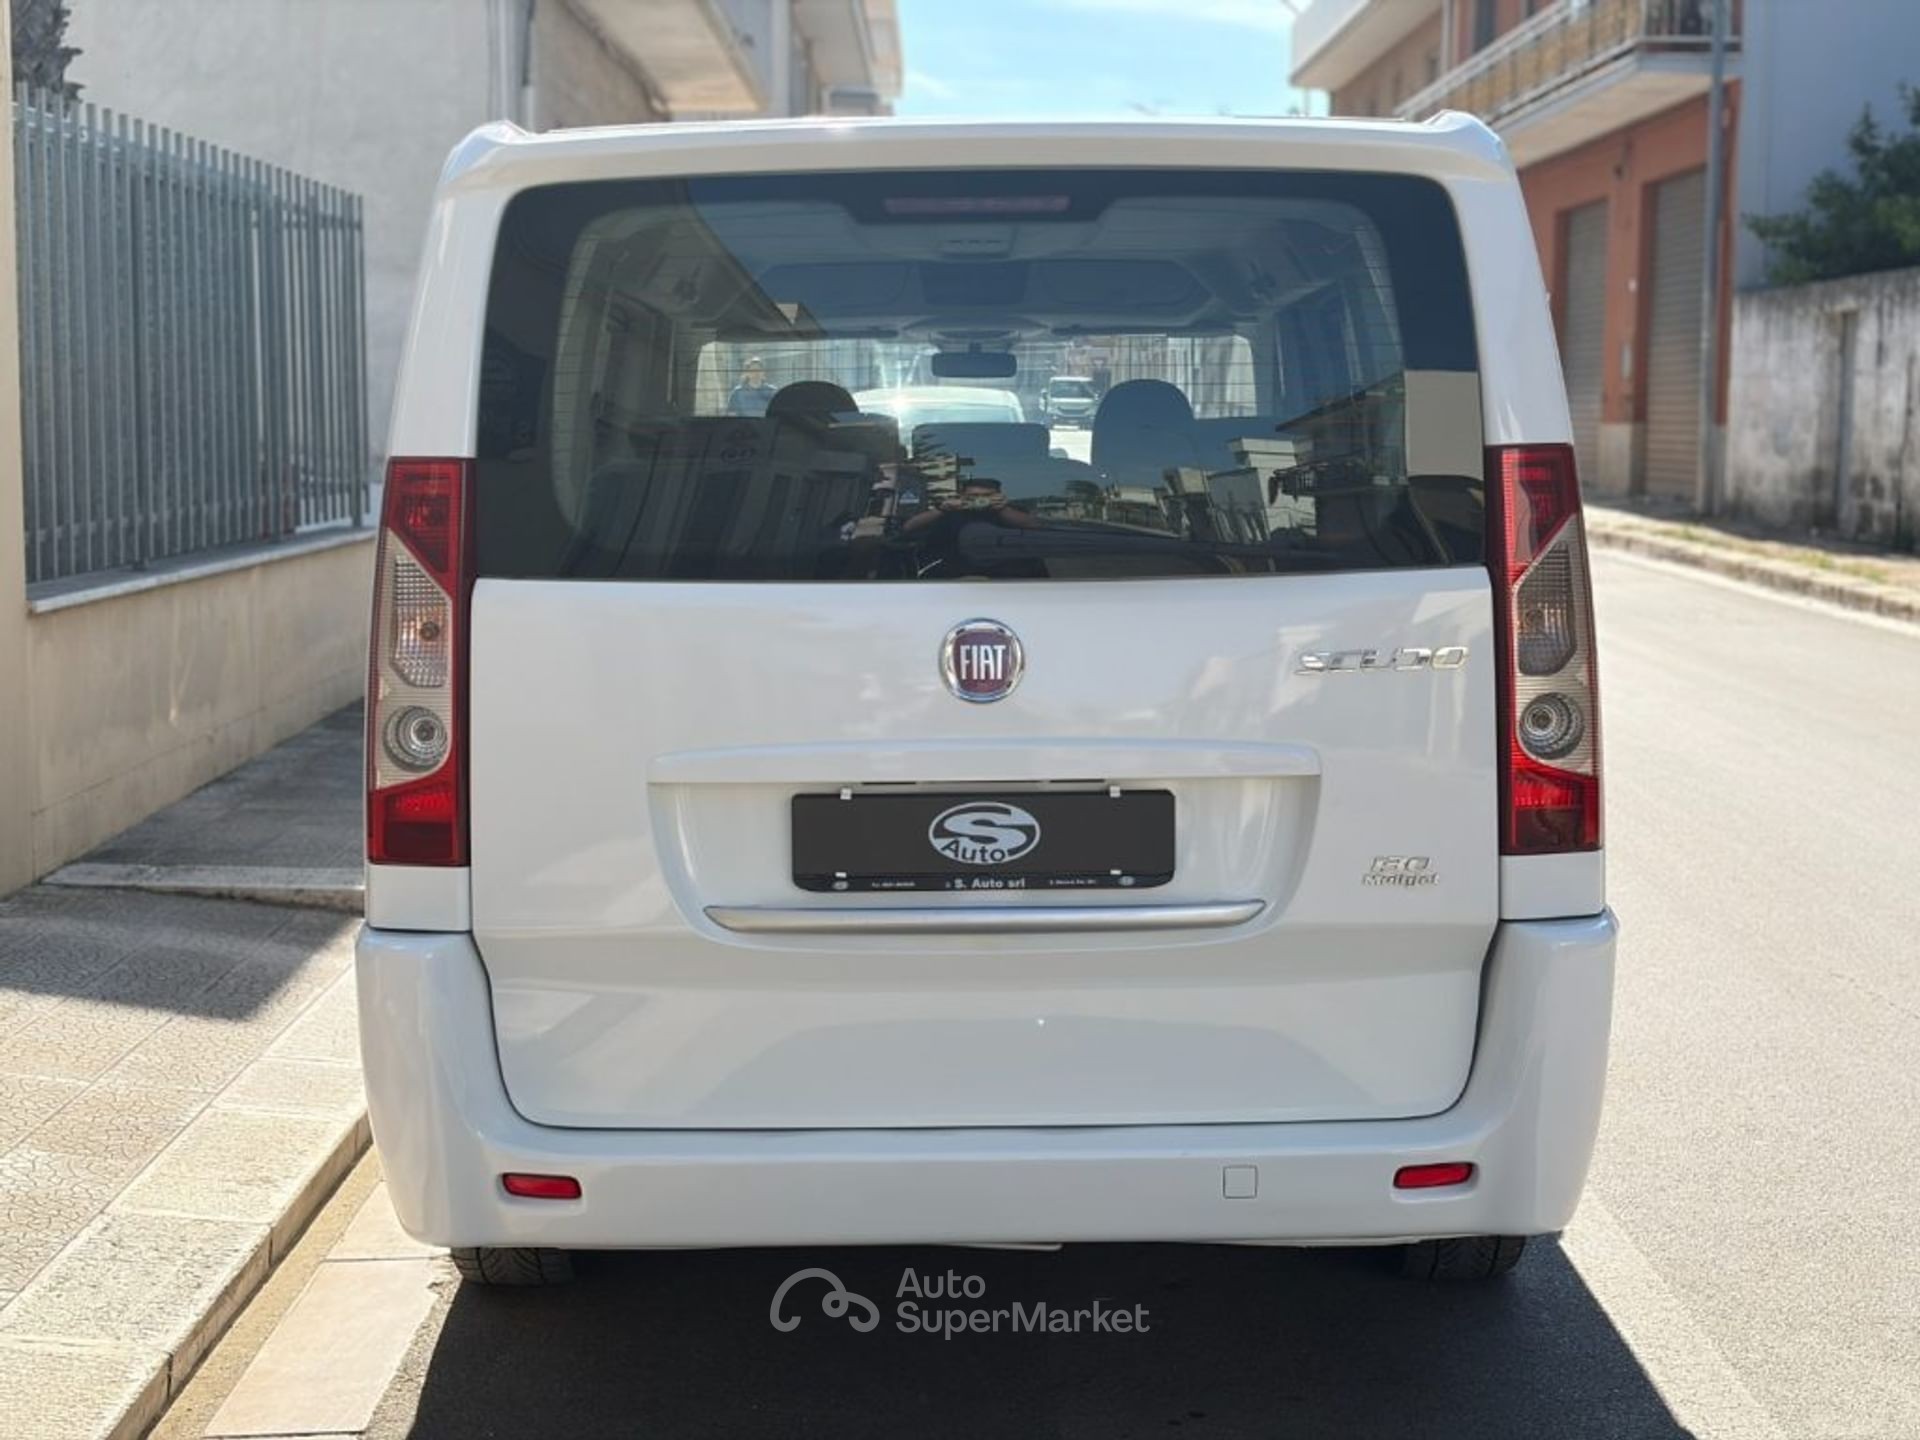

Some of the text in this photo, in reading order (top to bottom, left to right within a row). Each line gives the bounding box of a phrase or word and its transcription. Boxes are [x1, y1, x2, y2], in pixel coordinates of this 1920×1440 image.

[960, 644, 1006, 680] FIAT
[940, 838, 1006, 862] Auto
[971, 877, 1004, 889] Auto
